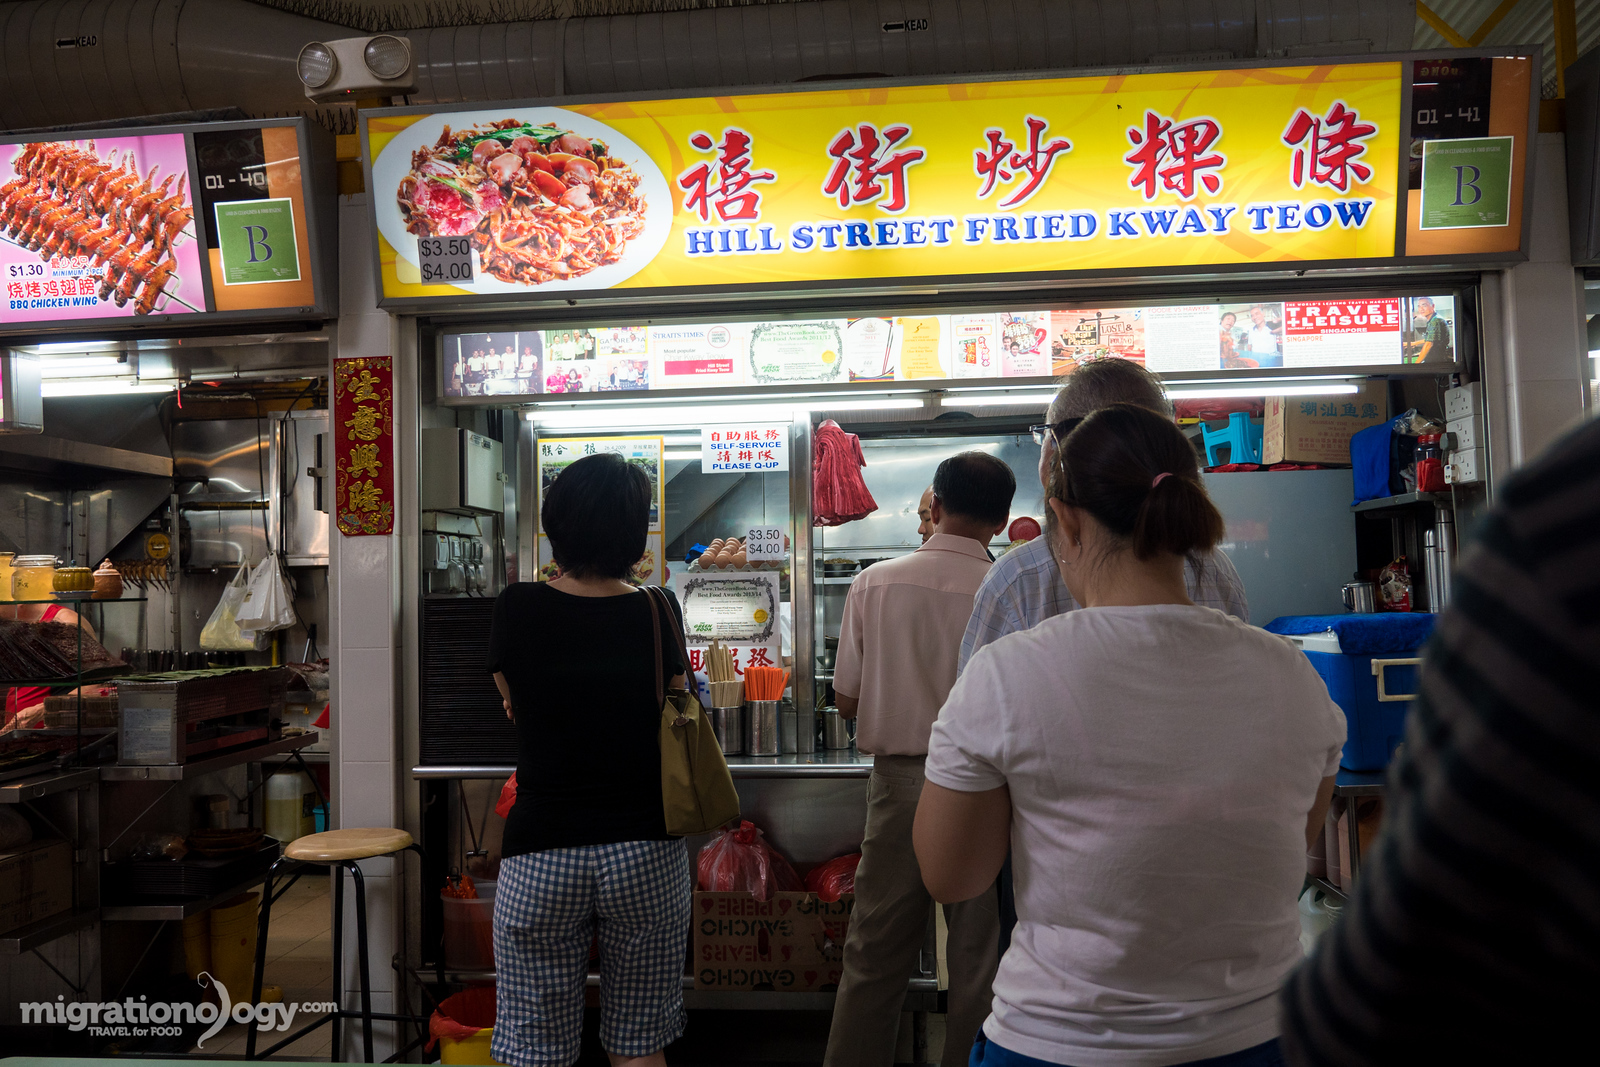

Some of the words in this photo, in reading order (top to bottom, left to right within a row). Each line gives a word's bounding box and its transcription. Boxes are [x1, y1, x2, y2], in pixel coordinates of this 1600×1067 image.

[904, 19, 928, 31] KEAD
[75, 35, 97, 47] KEAD
[1417, 109, 1438, 124] 01
[1458, 107, 1481, 122] 41
[205, 175, 224, 190] 01
[240, 172, 265, 187] 40
[1448, 165, 1482, 206] B
[687, 226, 781, 254] HILL
[792, 219, 955, 249] STREET
[965, 213, 1097, 242] FRIED
[1108, 206, 1236, 236] KWAY
[1247, 200, 1373, 230] TEOW
[241, 225, 273, 263] B
[421, 238, 470, 258] $3.50
[10, 264, 43, 277] $1.30
[422, 261, 471, 281] $4.00
[7, 277, 95, 299] 烧烤鸡翅膀
[10, 300, 28, 310] BBQ
[30, 298, 70, 308] CHICKEN
[73, 296, 98, 306] WING
[1148, 306, 1172, 314] FOODIE
[1286, 304, 1398, 317] TRAVEL
[1080, 324, 1096, 332] Our
[1102, 324, 1122, 334] LOST
[1300, 401, 1379, 419] 潮汕鱼露
[711, 430, 780, 442] 自助服務
[710, 441, 781, 450] SELF-SERVICE
[717, 450, 775, 462] 請排隊
[712, 462, 752, 470] PLEASE
[749, 530, 780, 540] $3.50
[749, 544, 780, 554] $4.00
[700, 919, 794, 936] GAUCHO
[700, 968, 795, 986] GAUCHO
